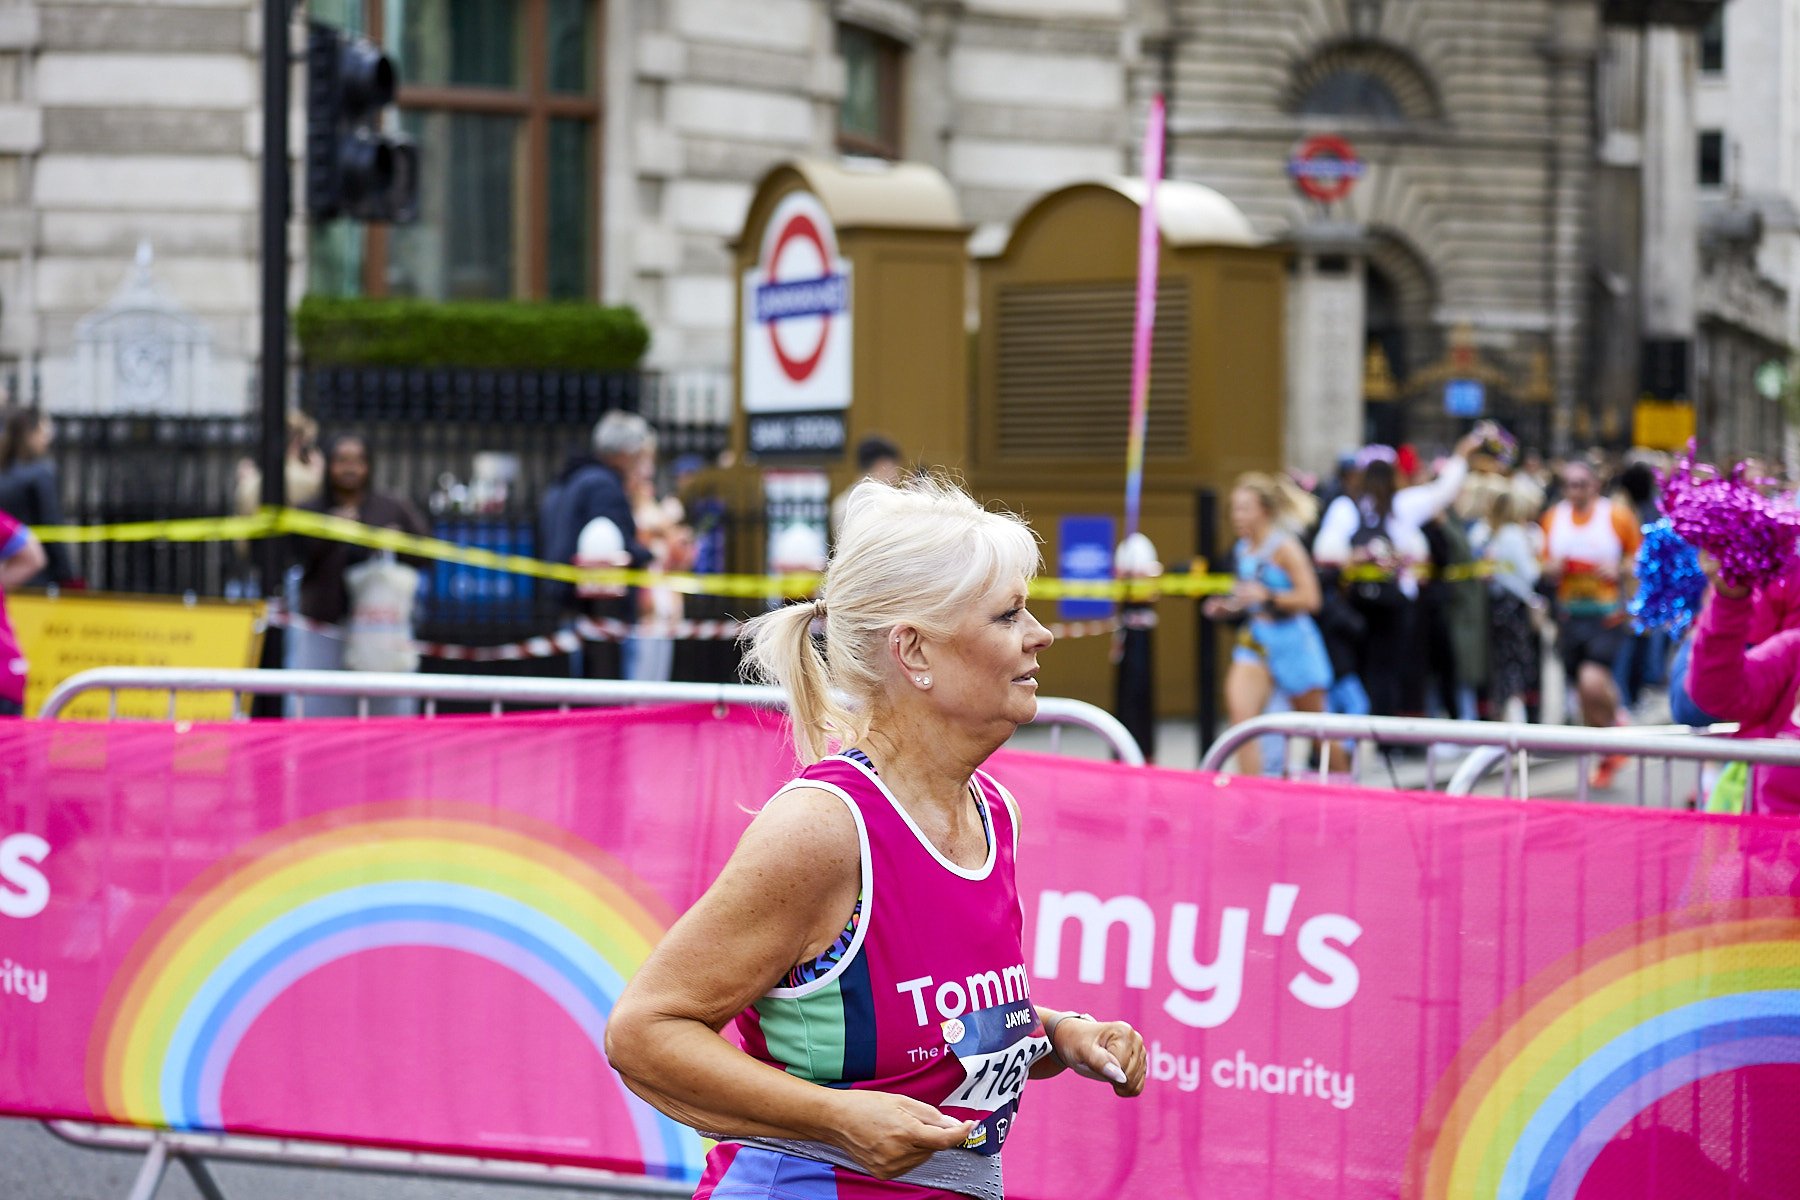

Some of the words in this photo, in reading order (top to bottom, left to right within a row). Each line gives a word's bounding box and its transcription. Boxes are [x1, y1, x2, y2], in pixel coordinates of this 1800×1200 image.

[1005, 1009, 1031, 1028] JAYNE
[907, 1046, 938, 1063] The
[1146, 1040, 1200, 1092] by
[1211, 1048, 1355, 1109] charity
